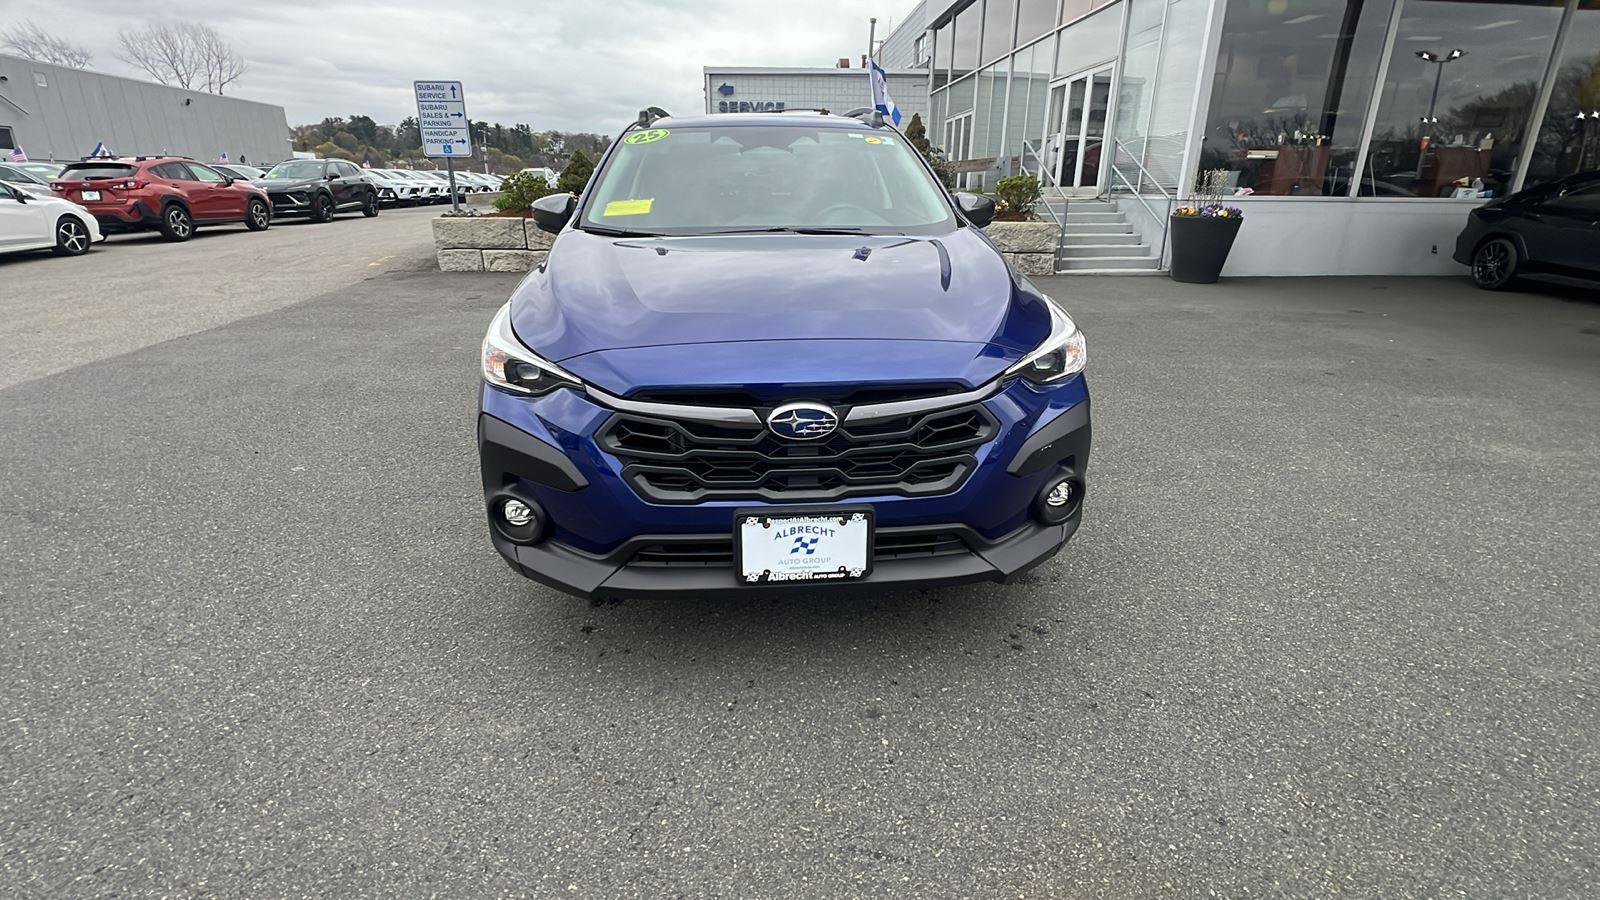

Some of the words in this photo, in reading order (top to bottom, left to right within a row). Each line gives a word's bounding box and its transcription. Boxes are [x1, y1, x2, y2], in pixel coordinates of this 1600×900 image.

[719, 101, 785, 113] SERVICE
[633, 130, 660, 143] 25
[774, 525, 836, 541] ALBRECHT
[778, 558, 801, 566] AUTO
[802, 557, 831, 565] GROUP
[767, 571, 814, 582] Albrecht
